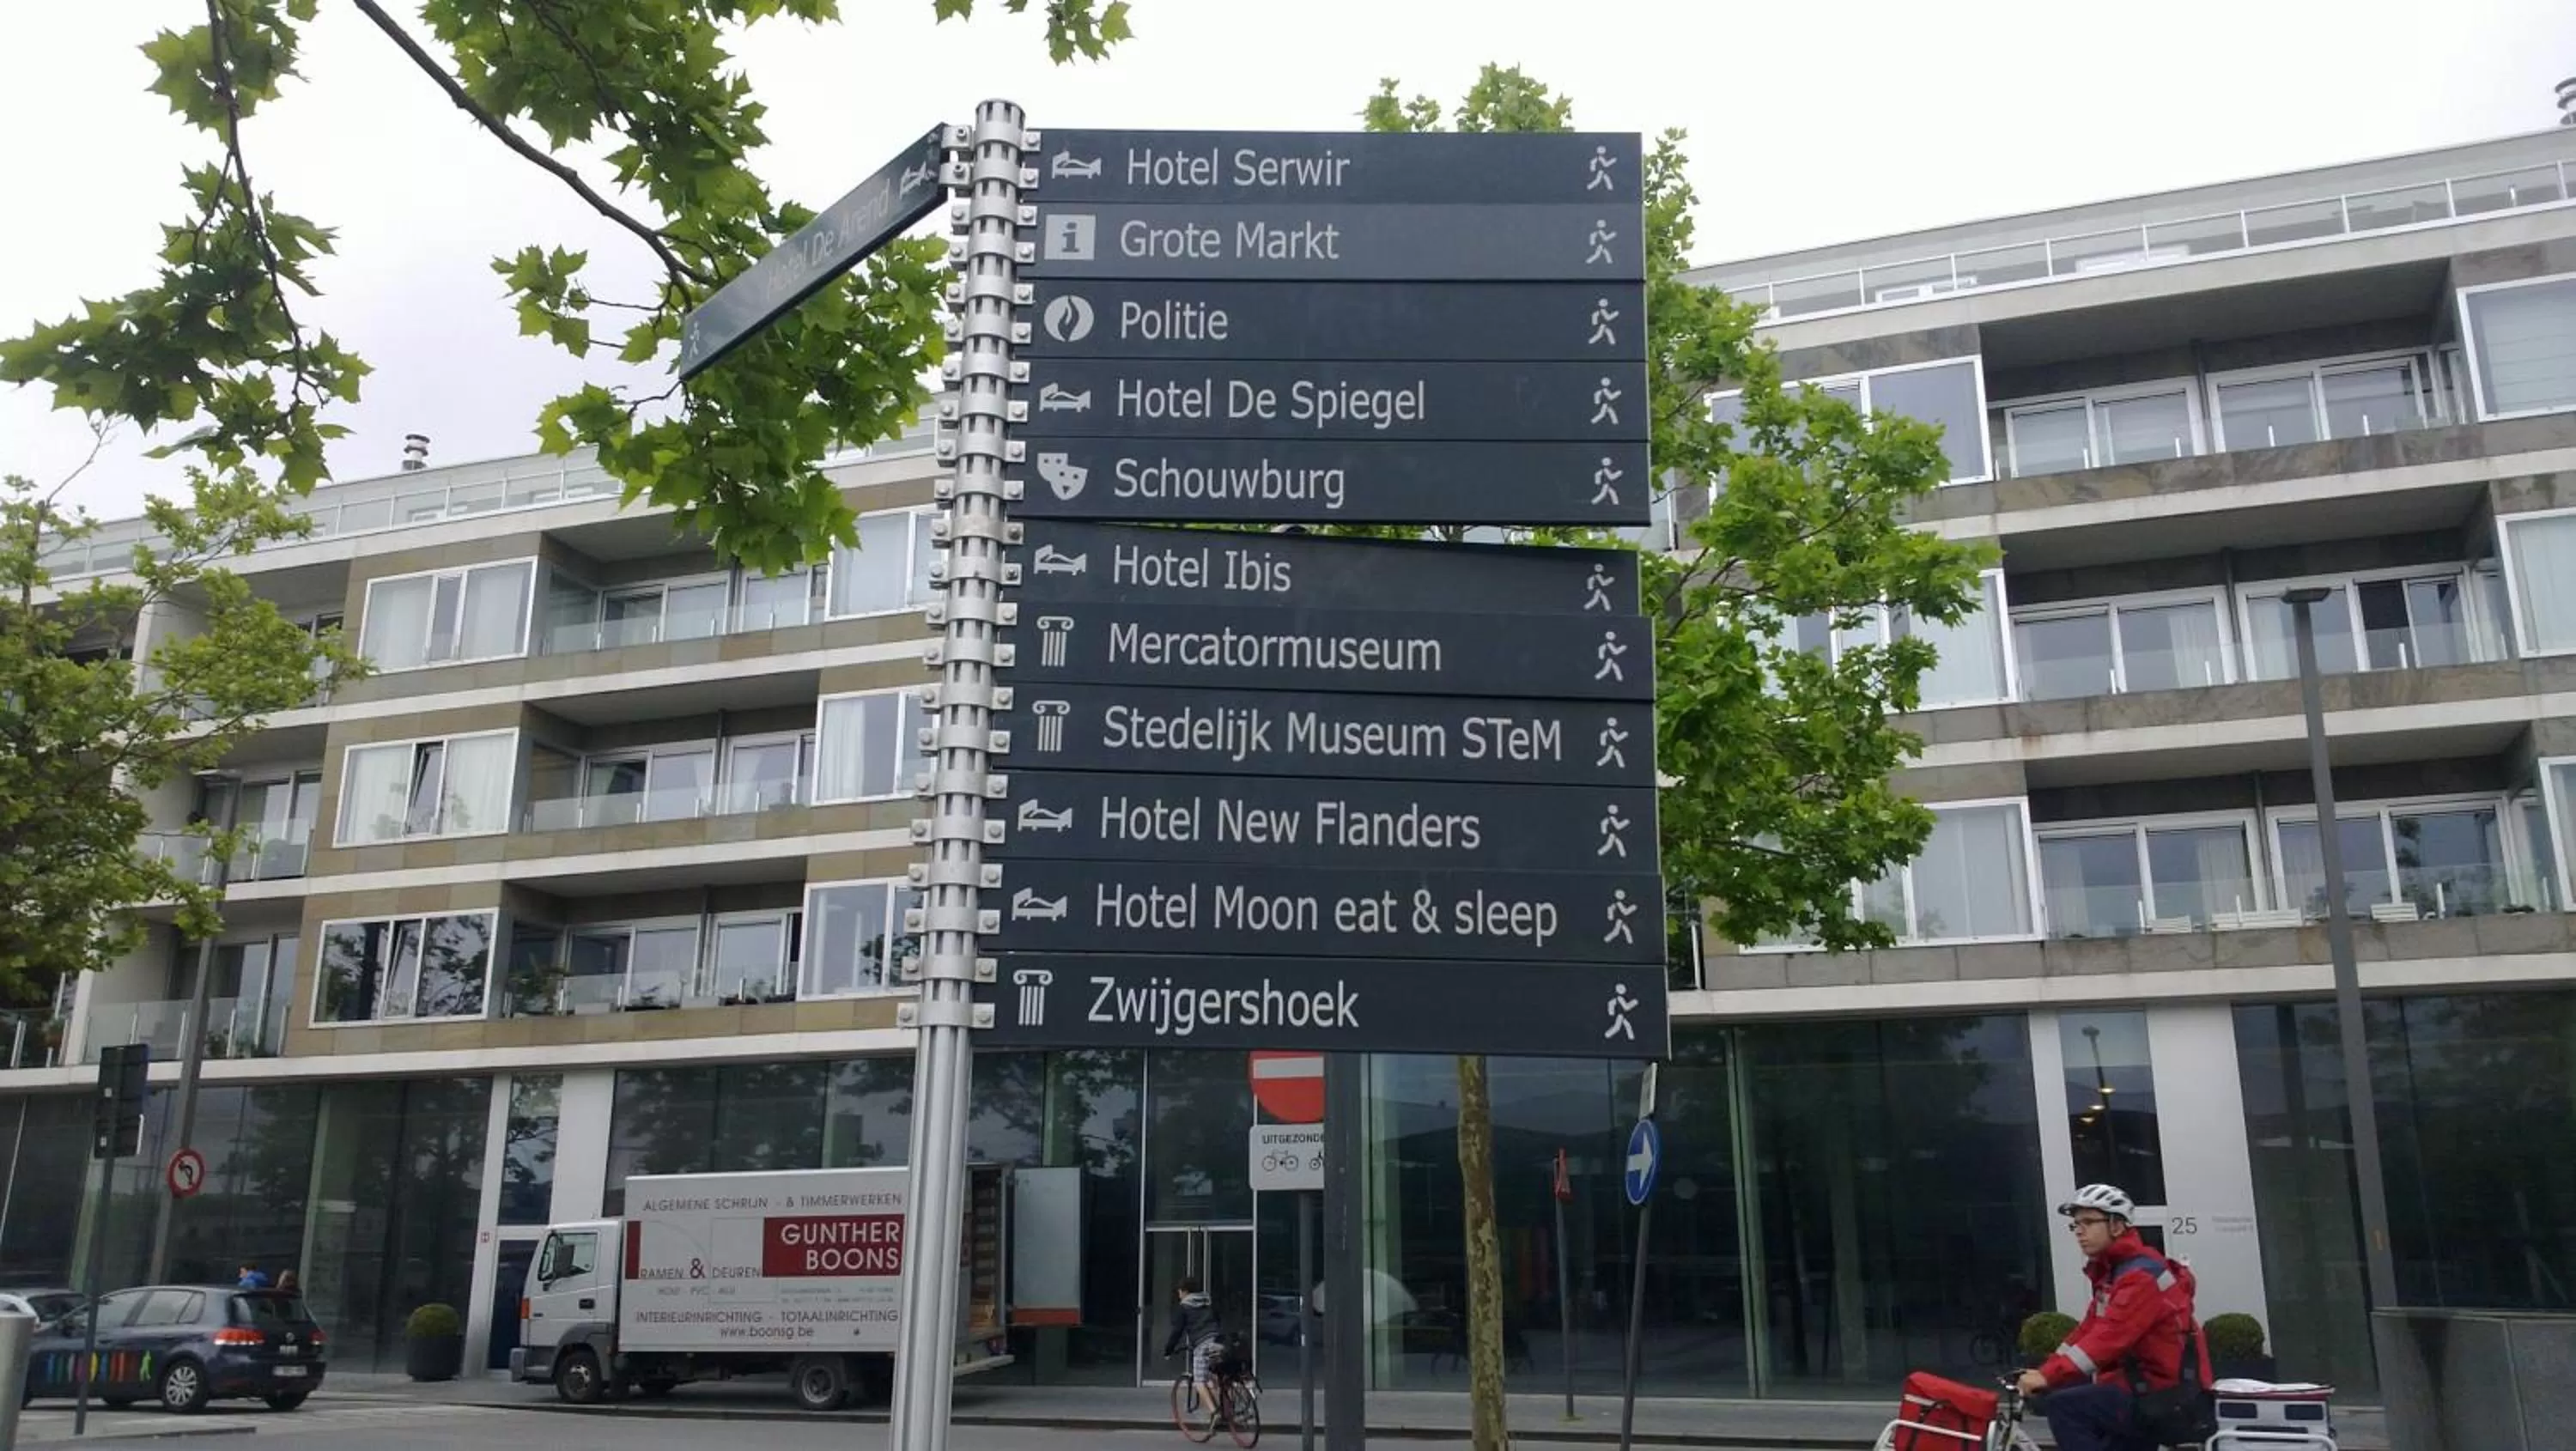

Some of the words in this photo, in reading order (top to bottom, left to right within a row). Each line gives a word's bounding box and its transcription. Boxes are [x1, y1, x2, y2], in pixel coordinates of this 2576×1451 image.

[1127, 147, 1219, 186] Hotel
[1233, 149, 1351, 186] Serwir
[811, 228, 835, 265] De
[1120, 219, 1222, 259] Grote
[1236, 220, 1340, 260] Markt
[1120, 300, 1228, 340] Politie
[1117, 378, 1212, 418] Hotel
[1229, 380, 1276, 419] De
[1291, 380, 1425, 429] Spiegel
[1114, 457, 1346, 509] Schouwburg
[1114, 544, 1208, 589] Hotel
[1224, 549, 1291, 592] Ibis
[1109, 622, 1441, 671] Mercatormuseum
[1103, 705, 1271, 762] Stedelijk
[1287, 712, 1445, 757] Museum
[1462, 716, 1561, 762] STeM
[1100, 795, 1200, 841] Hotel
[1218, 798, 1300, 843] New
[1316, 801, 1480, 849] Flanders
[1096, 883, 1196, 928] Hotel
[1215, 885, 1318, 931] Moon
[1334, 890, 1398, 933] eat
[1413, 889, 1441, 933] &
[1455, 889, 1558, 947] sleep
[1088, 976, 1359, 1035] Zwijgershoek
[642, 1198, 710, 1211] ALGEMENE
[714, 1197, 768, 1209] SCHRIJN
[801, 1193, 902, 1207] TIMMERWERKEN
[781, 1221, 901, 1244] GUNTHER
[2172, 1217, 2197, 1235] 25
[641, 1267, 683, 1279] RAMEN
[690, 1258, 706, 1278] &
[712, 1266, 760, 1278] DEUREN
[806, 1248, 900, 1270] BOONS
[636, 1311, 762, 1323] INTERIEURINRICHTING
[781, 1309, 898, 1323] TOTAALINRICHTING
[720, 1326, 814, 1339] www.boonsgbe
